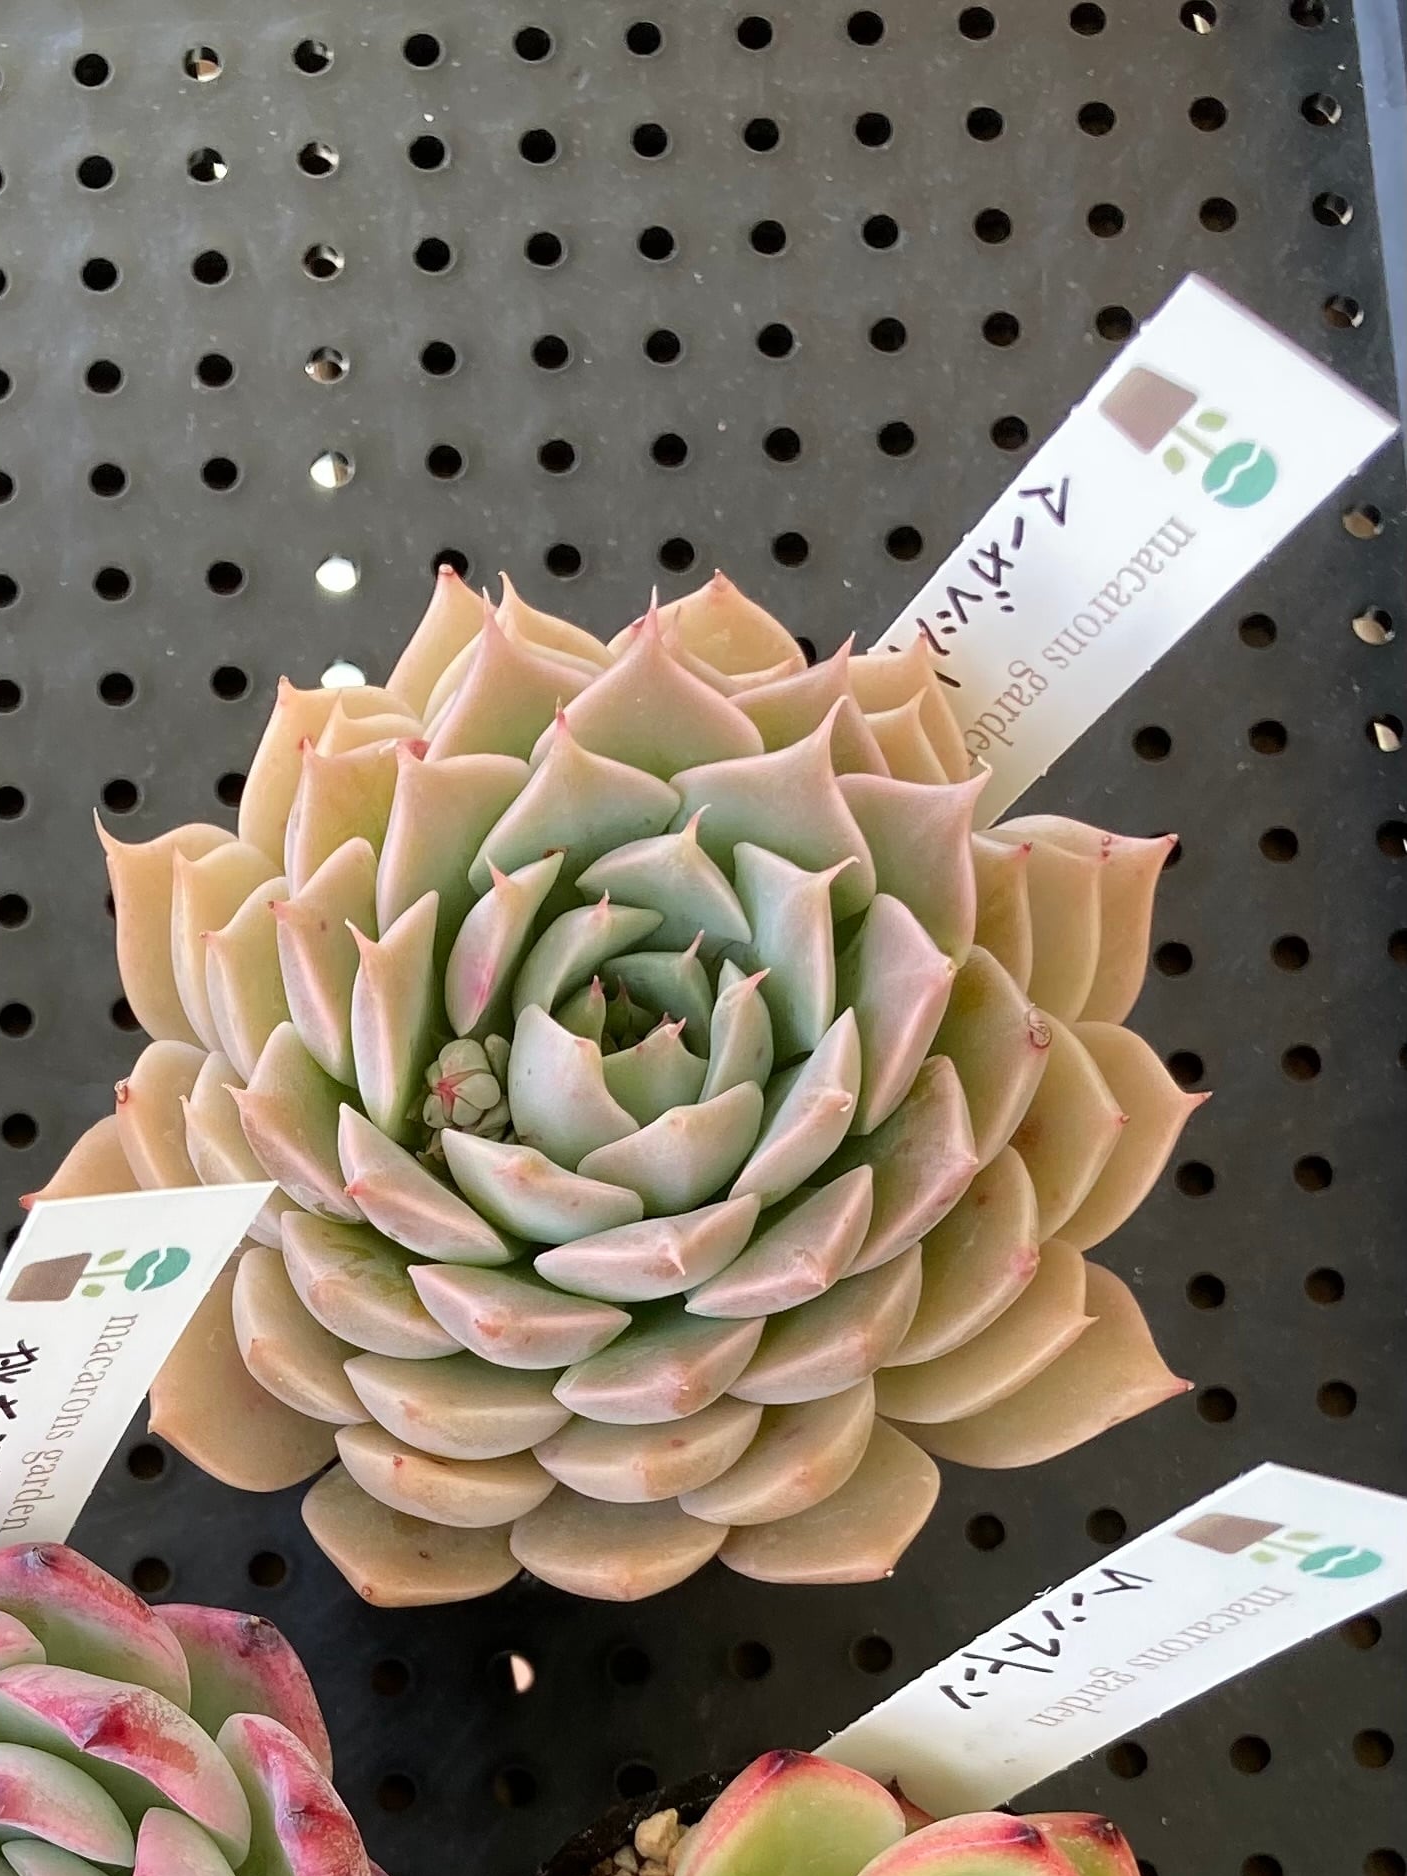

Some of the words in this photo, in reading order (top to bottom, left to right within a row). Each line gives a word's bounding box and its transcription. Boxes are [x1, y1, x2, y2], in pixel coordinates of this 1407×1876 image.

[1040, 515, 1196, 669] macarons
[45, 1313, 139, 1442] macarons
[1126, 1584, 1294, 1672] macarons
[1026, 1666, 1136, 1729] garden
